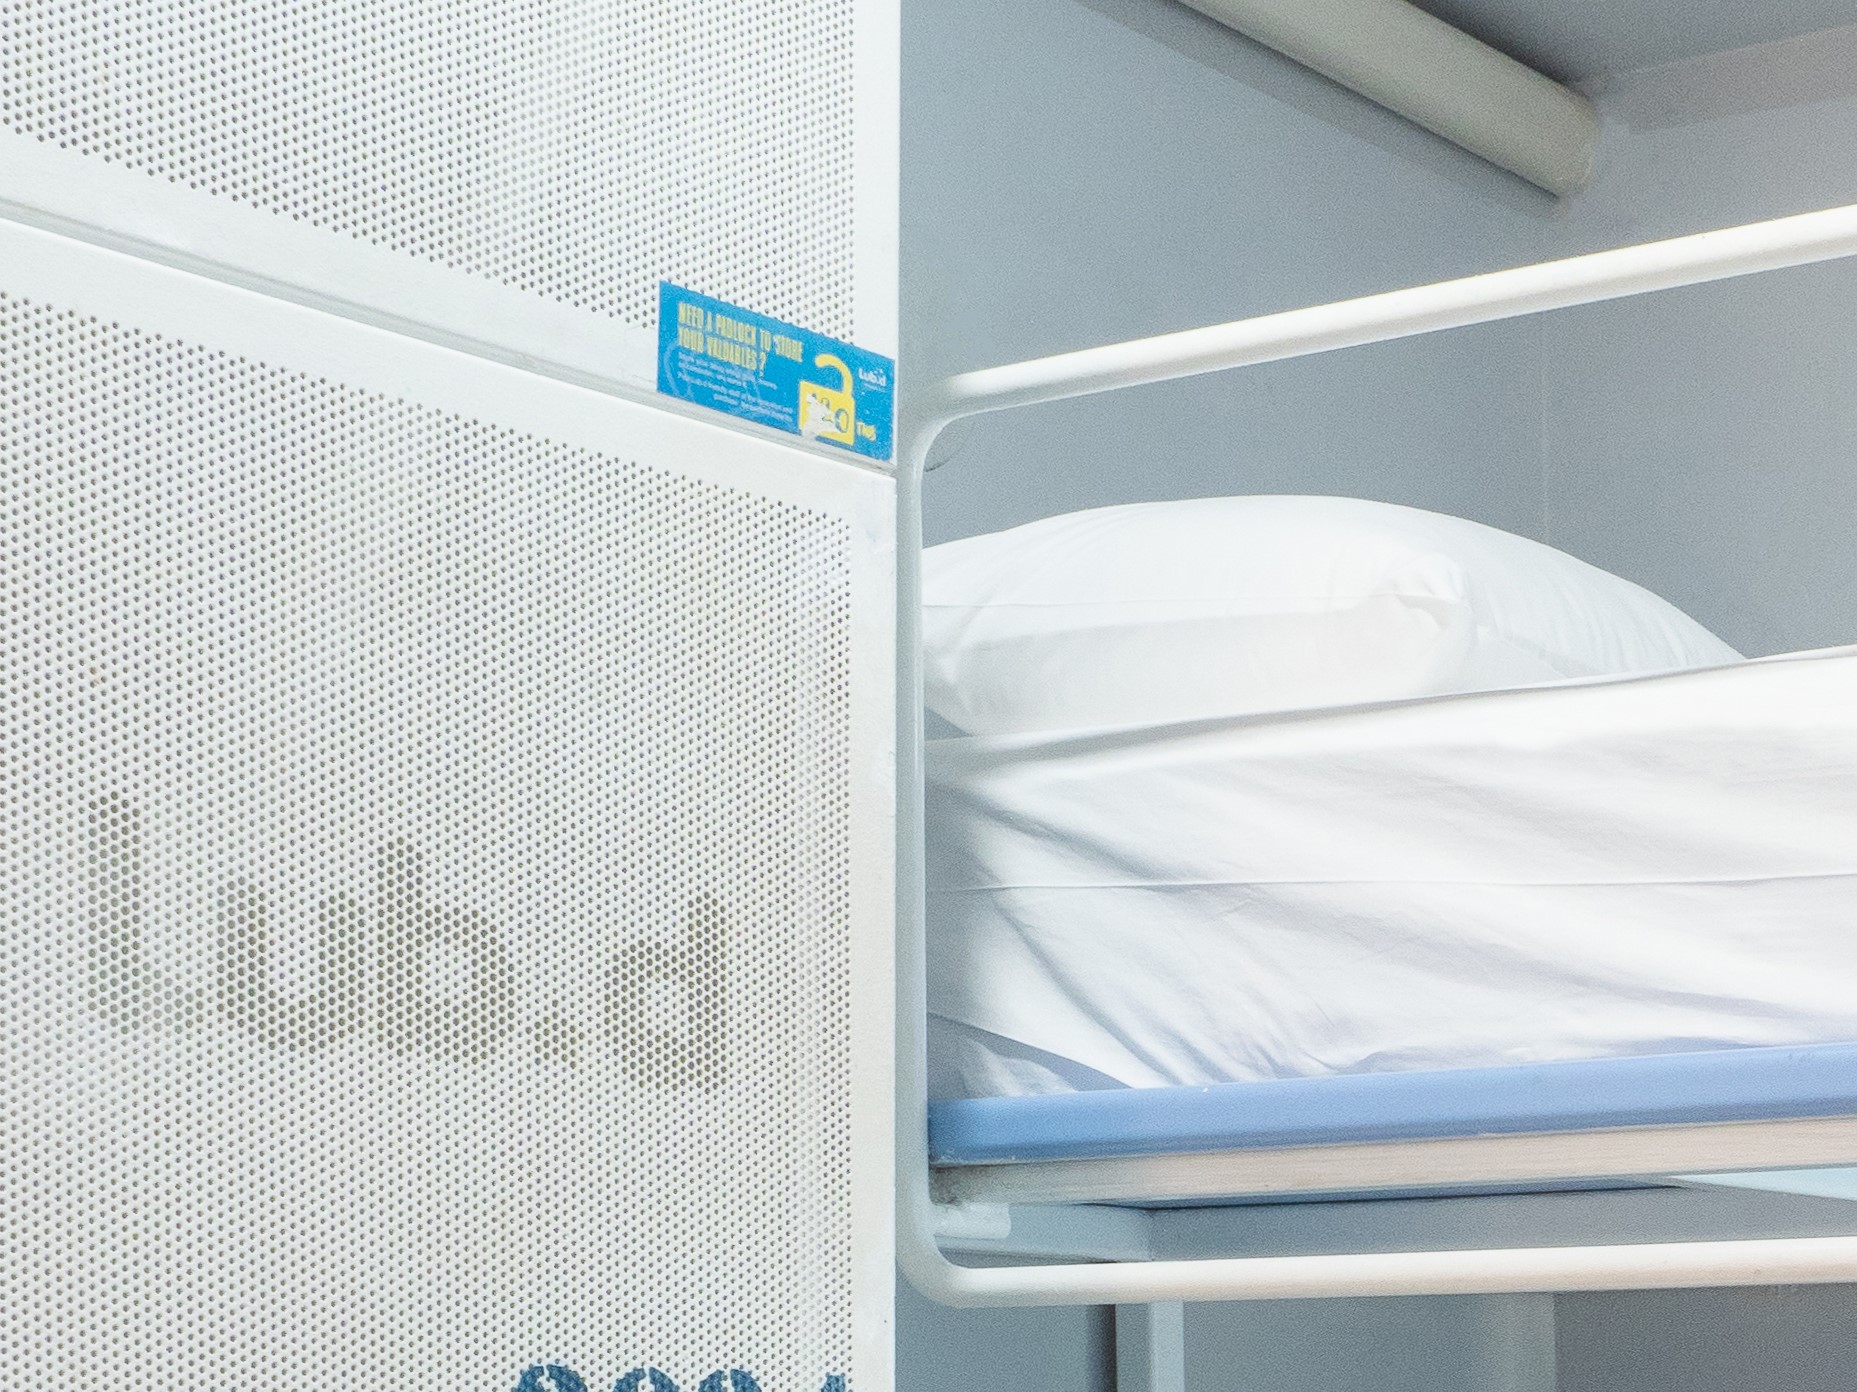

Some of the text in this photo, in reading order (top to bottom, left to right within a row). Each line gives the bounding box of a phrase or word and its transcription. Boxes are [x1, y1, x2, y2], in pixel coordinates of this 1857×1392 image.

[678, 302, 803, 363] NEED A PADLOCK TO STORE
[678, 327, 704, 354] YOUR
[706, 335, 757, 372] VALUABLES
[86, 790, 729, 1092] Lub.d
